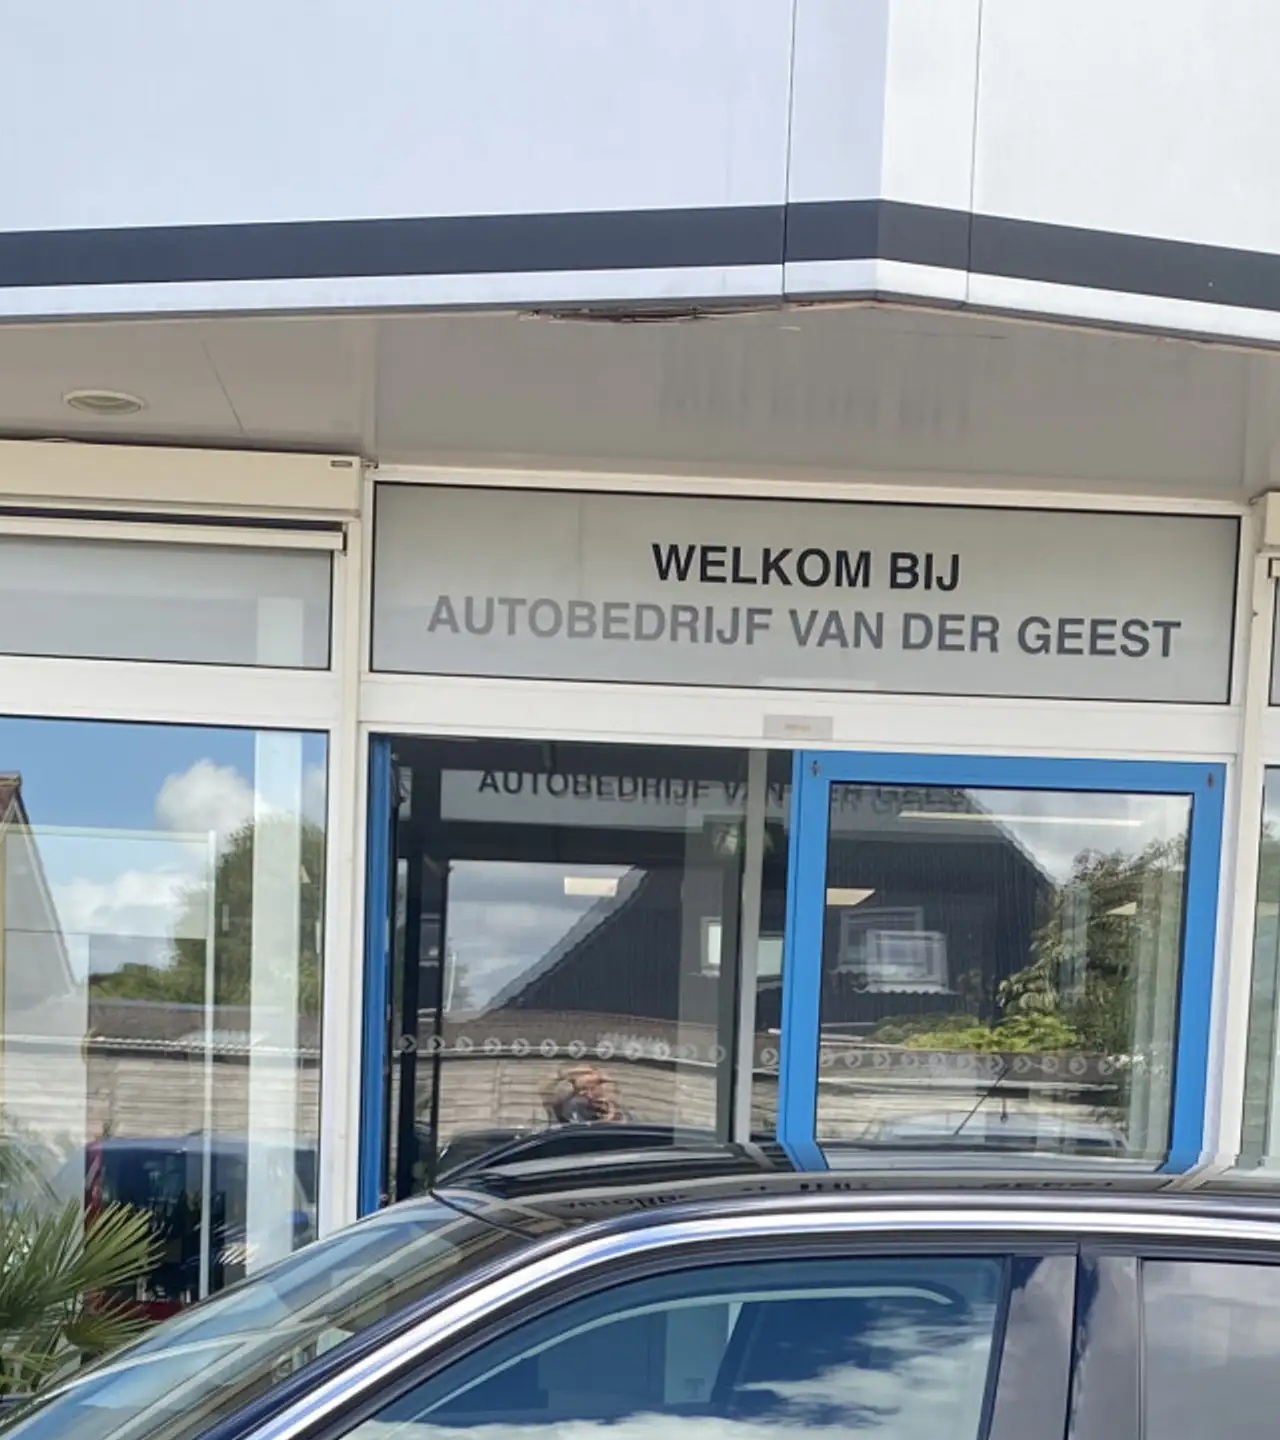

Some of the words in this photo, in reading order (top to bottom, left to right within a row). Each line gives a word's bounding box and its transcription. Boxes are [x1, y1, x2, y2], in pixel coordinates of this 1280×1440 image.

[652, 543, 871, 589] WELKOM
[889, 551, 961, 592] BIJ
[427, 595, 772, 646] AUTOBEDRIJF
[789, 608, 884, 650] VAN
[901, 613, 1000, 654] DER
[1016, 615, 1182, 660] GEEST
